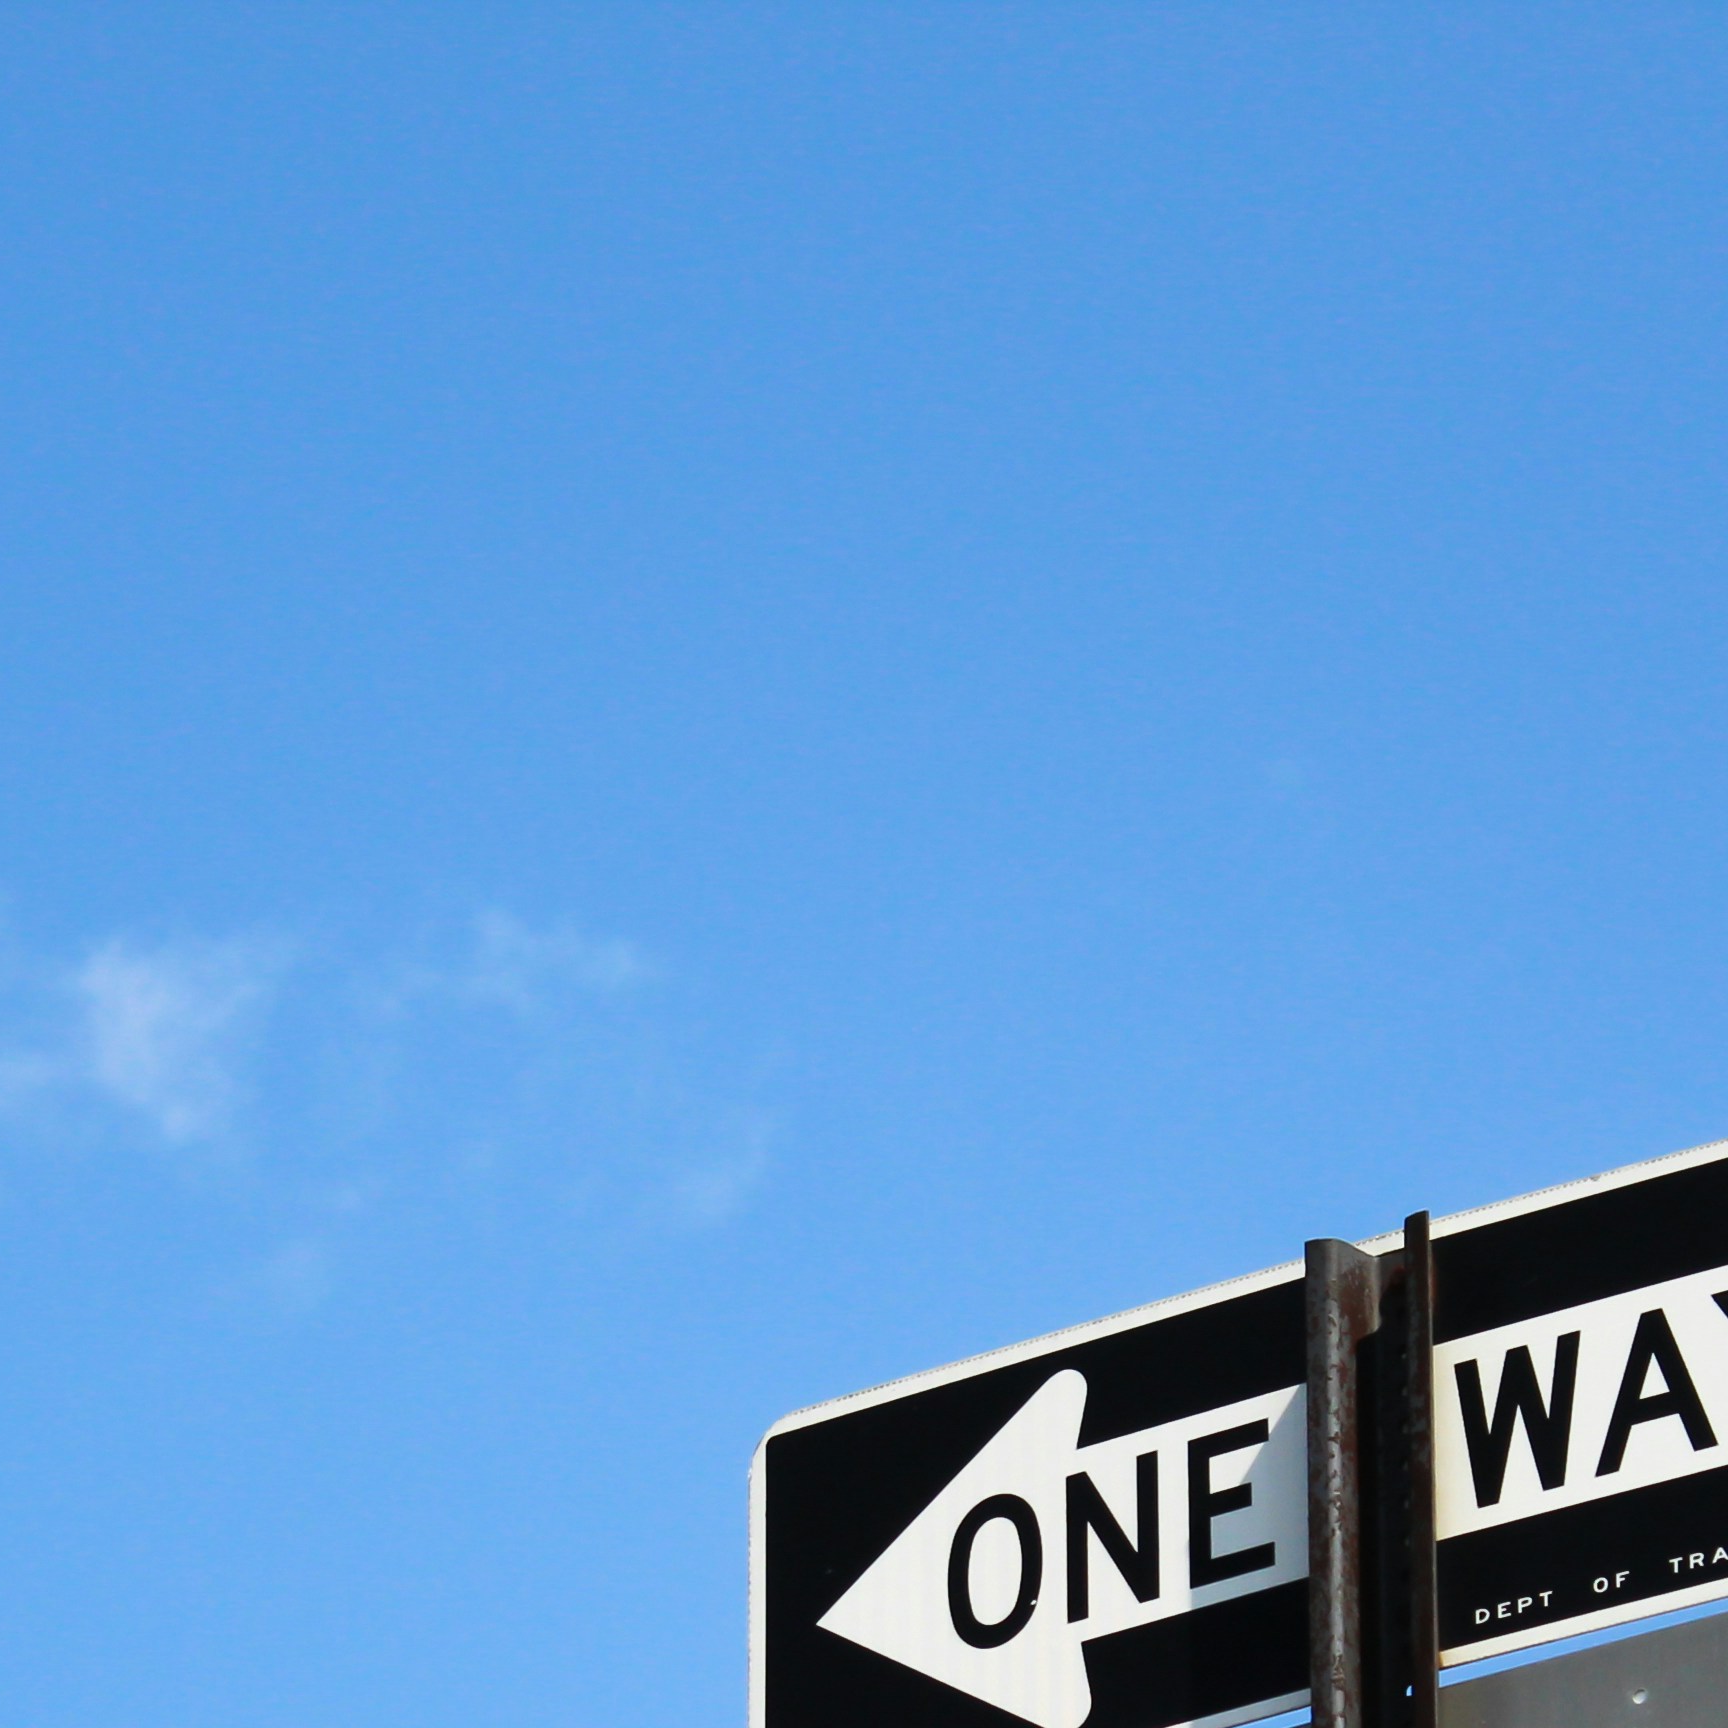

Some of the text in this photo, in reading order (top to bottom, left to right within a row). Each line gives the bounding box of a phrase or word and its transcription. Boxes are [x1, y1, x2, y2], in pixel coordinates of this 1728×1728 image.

[947, 1417, 1275, 1650] ONE
[1474, 1590, 1554, 1625] DEPT
[1592, 1570, 1631, 1594] OF
